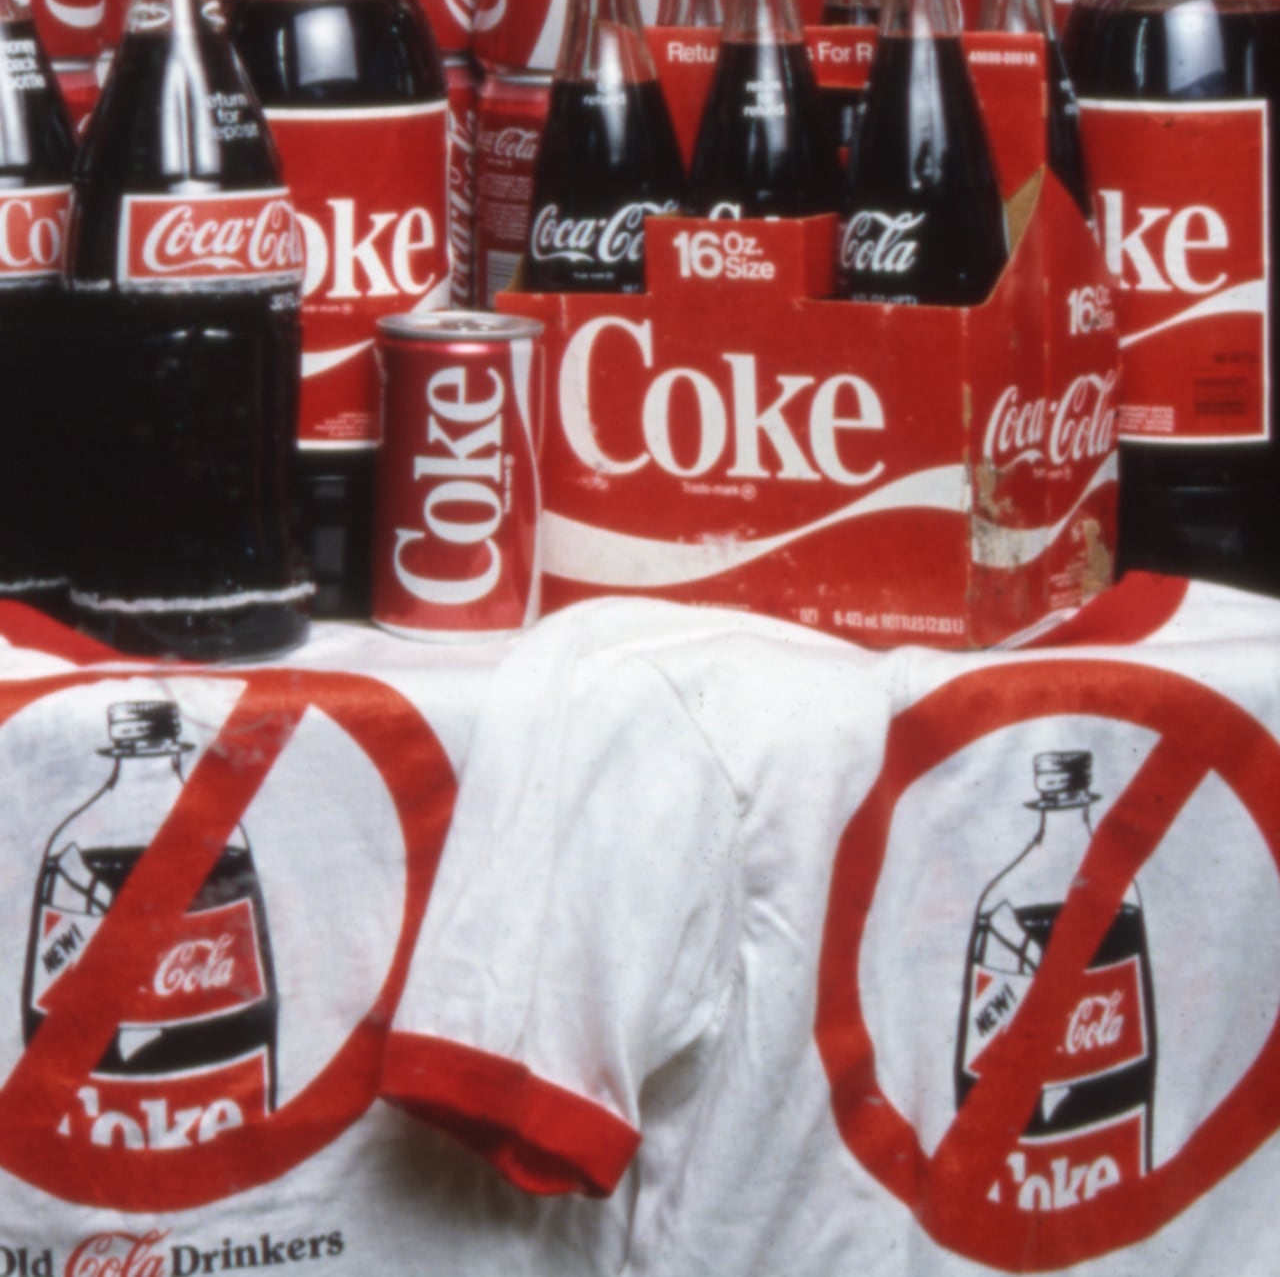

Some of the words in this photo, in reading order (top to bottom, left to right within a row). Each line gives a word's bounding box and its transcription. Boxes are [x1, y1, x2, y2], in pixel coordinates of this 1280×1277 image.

[667, 41, 717, 63] Retu
[817, 42, 852, 62] For
[672, 231, 723, 280] 16
[723, 231, 763, 256] Oz.
[724, 257, 776, 280] Size
[1099, 190, 1229, 294] ke
[1068, 288, 1094, 335] 16
[559, 315, 885, 486] Coke
[394, 366, 505, 605] Coke
[153, 934, 235, 998] Cola
[1066, 990, 1125, 1054] Cola
[171, 1229, 345, 1277] Drinkers
